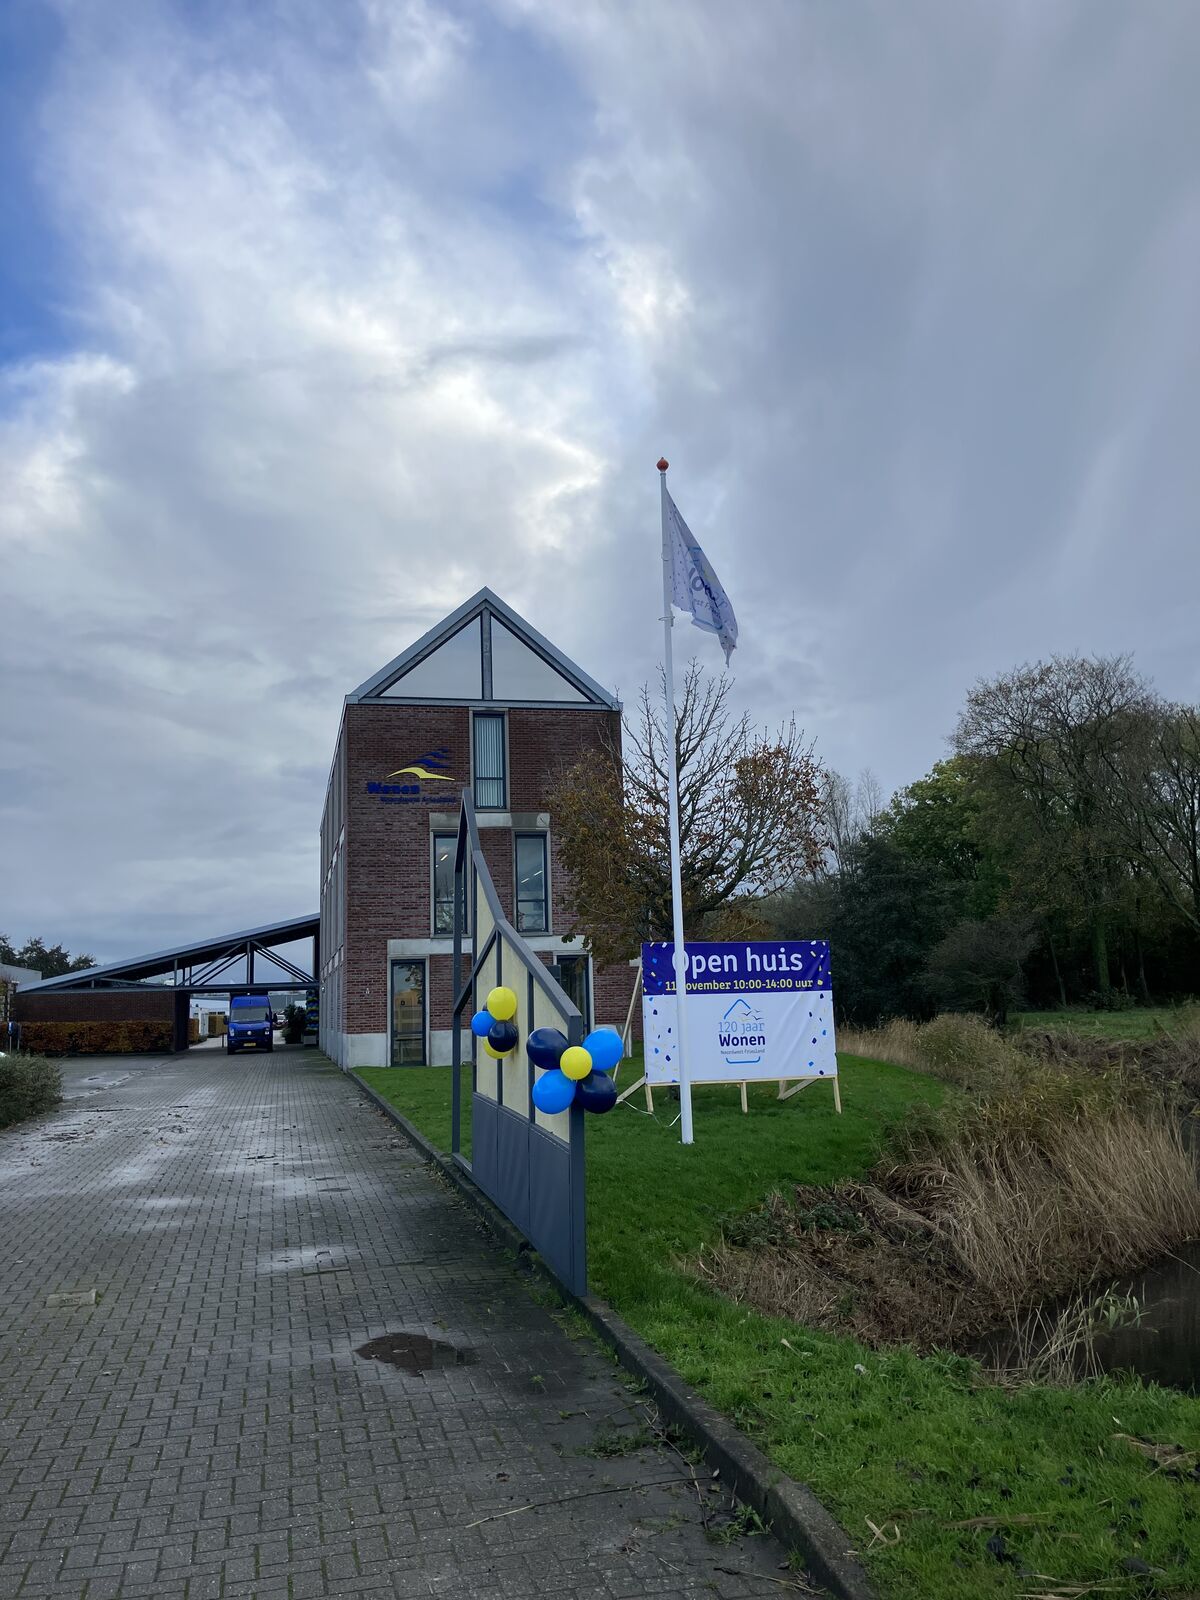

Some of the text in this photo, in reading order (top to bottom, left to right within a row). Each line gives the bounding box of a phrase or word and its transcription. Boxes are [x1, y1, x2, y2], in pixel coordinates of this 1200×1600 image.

[747, 947, 803, 972] huis
[665, 979, 813, 991] 11 ovember 10:00-14:00 uur
[718, 1021, 765, 1034] 120 jaar
[719, 1033, 766, 1047] Wonen
